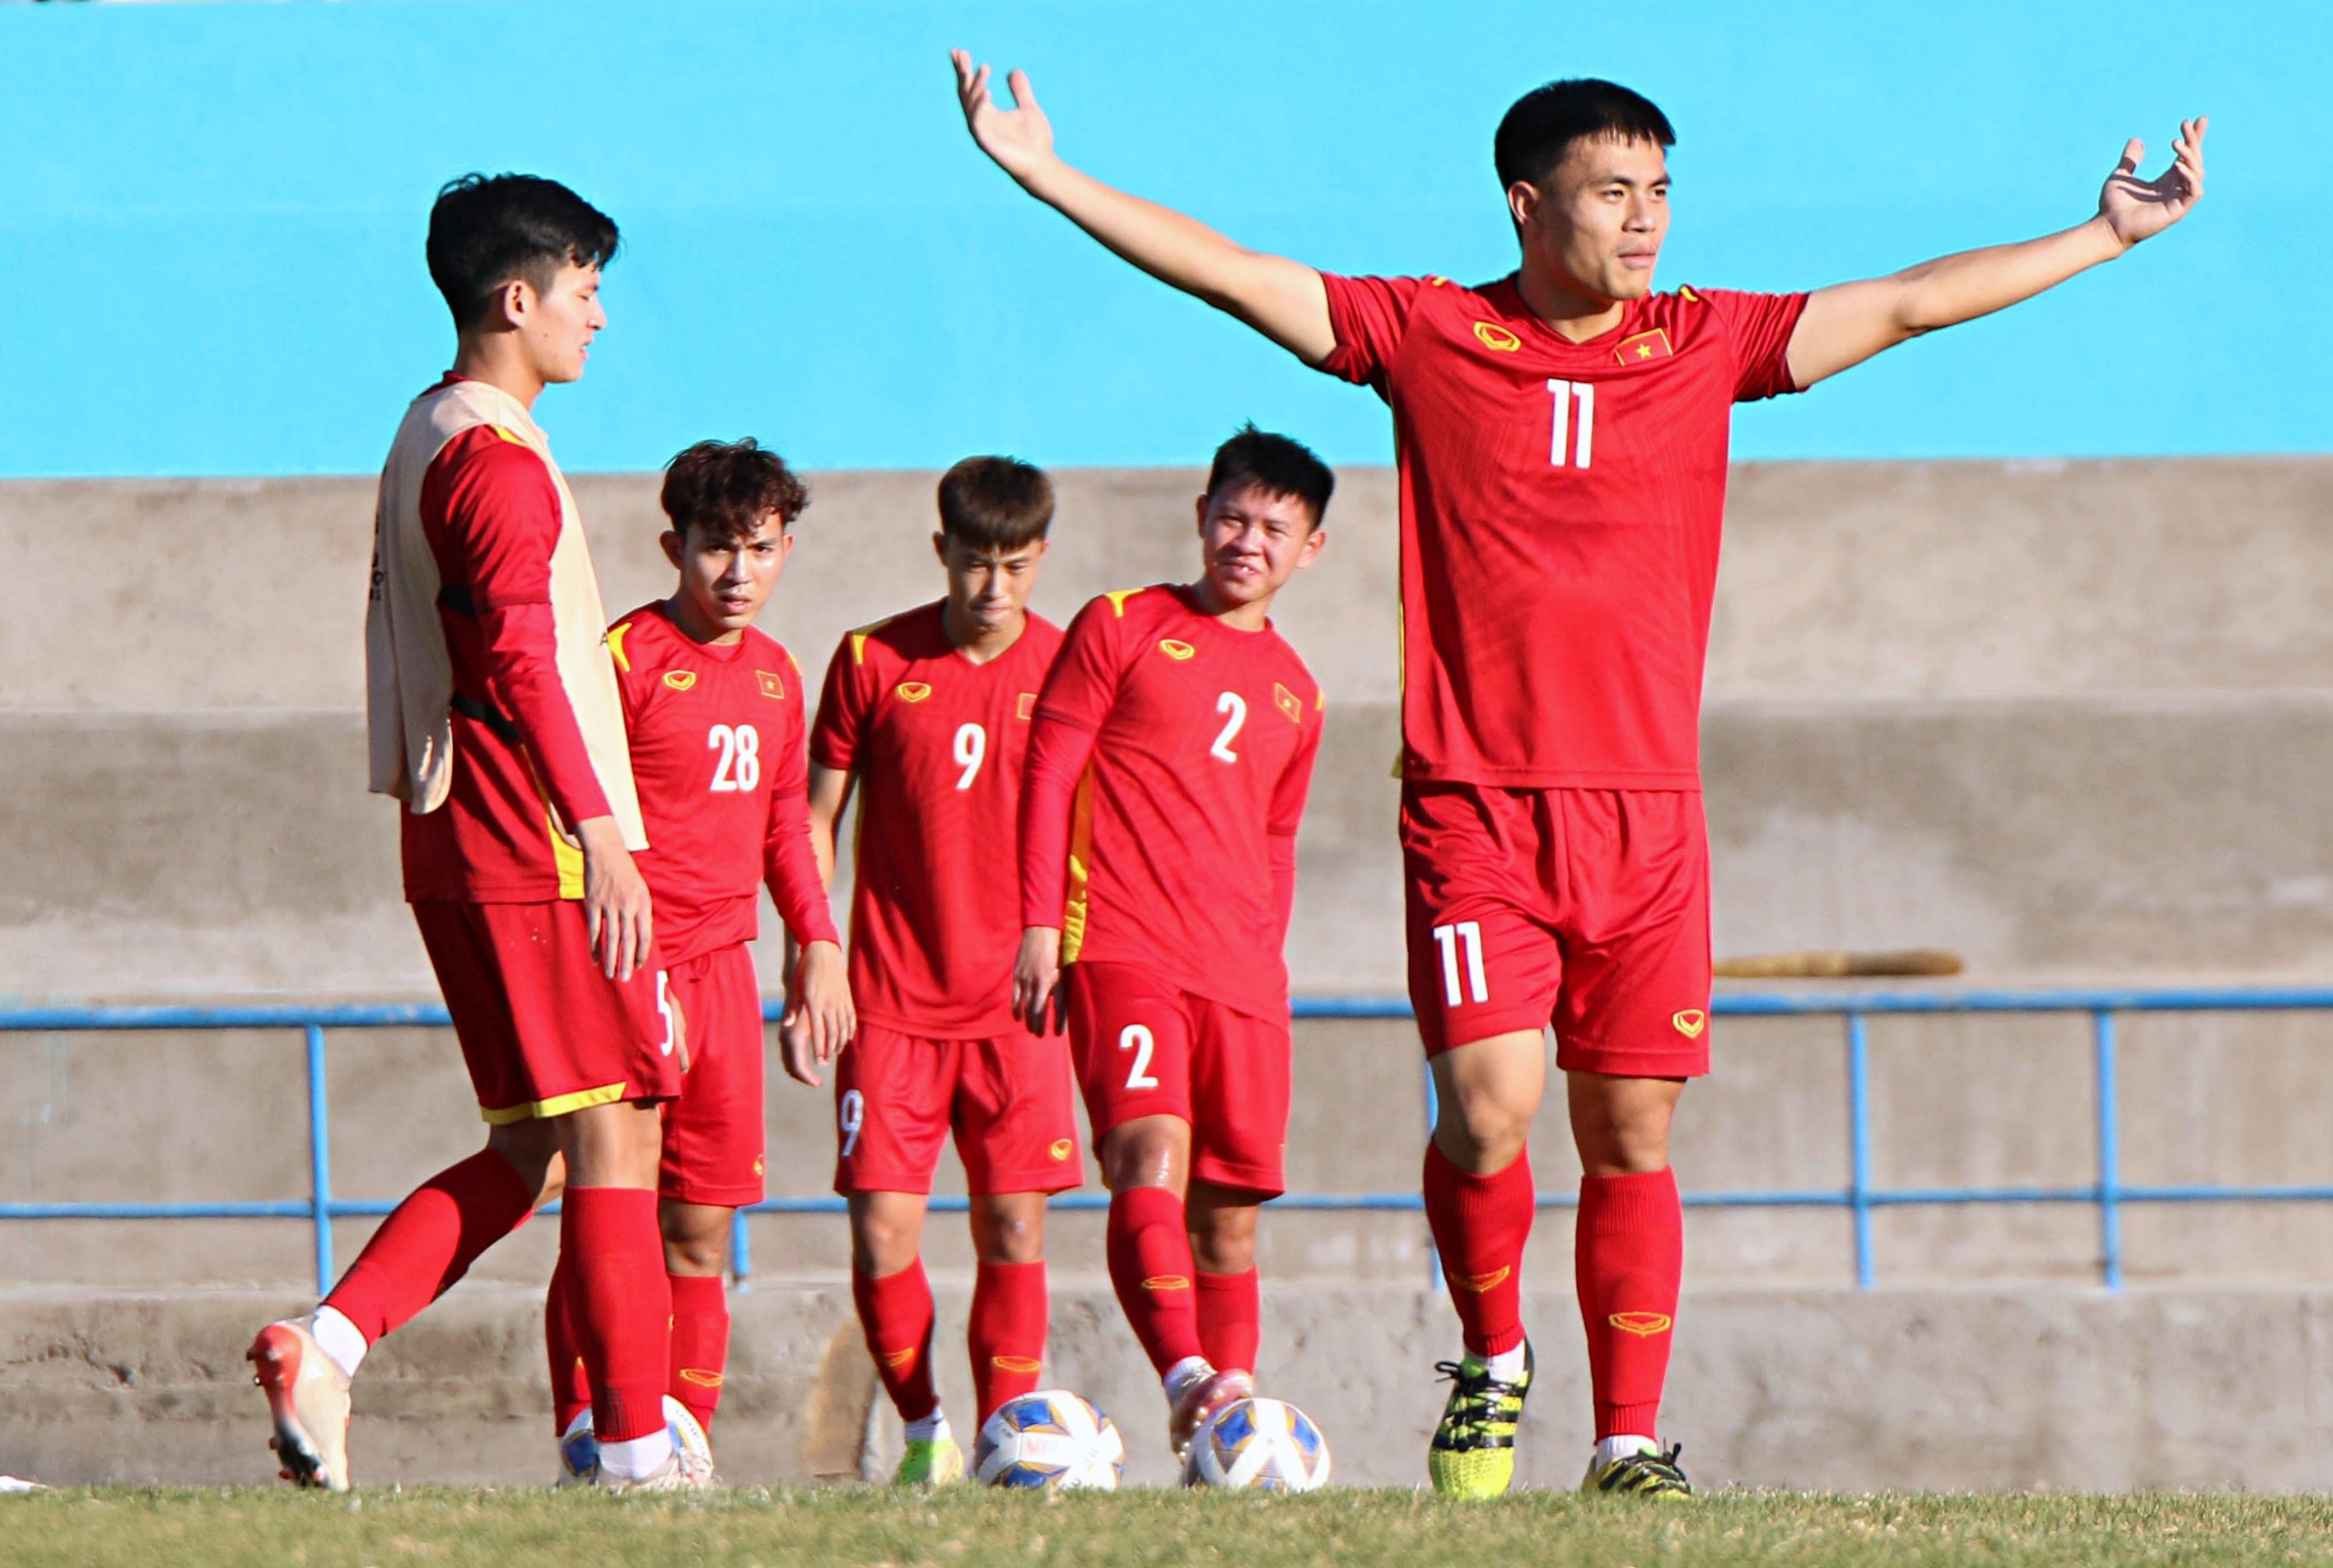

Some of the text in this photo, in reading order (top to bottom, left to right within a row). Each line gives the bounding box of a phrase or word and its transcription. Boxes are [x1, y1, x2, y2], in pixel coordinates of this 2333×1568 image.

[1547, 378, 1594, 469] 11
[708, 724, 760, 792] 28
[954, 723, 986, 791] 9
[1210, 691, 1247, 763] 2
[1434, 922, 1489, 1007] 11
[1119, 1024, 1159, 1090] 2
[839, 1089, 864, 1158] 9
